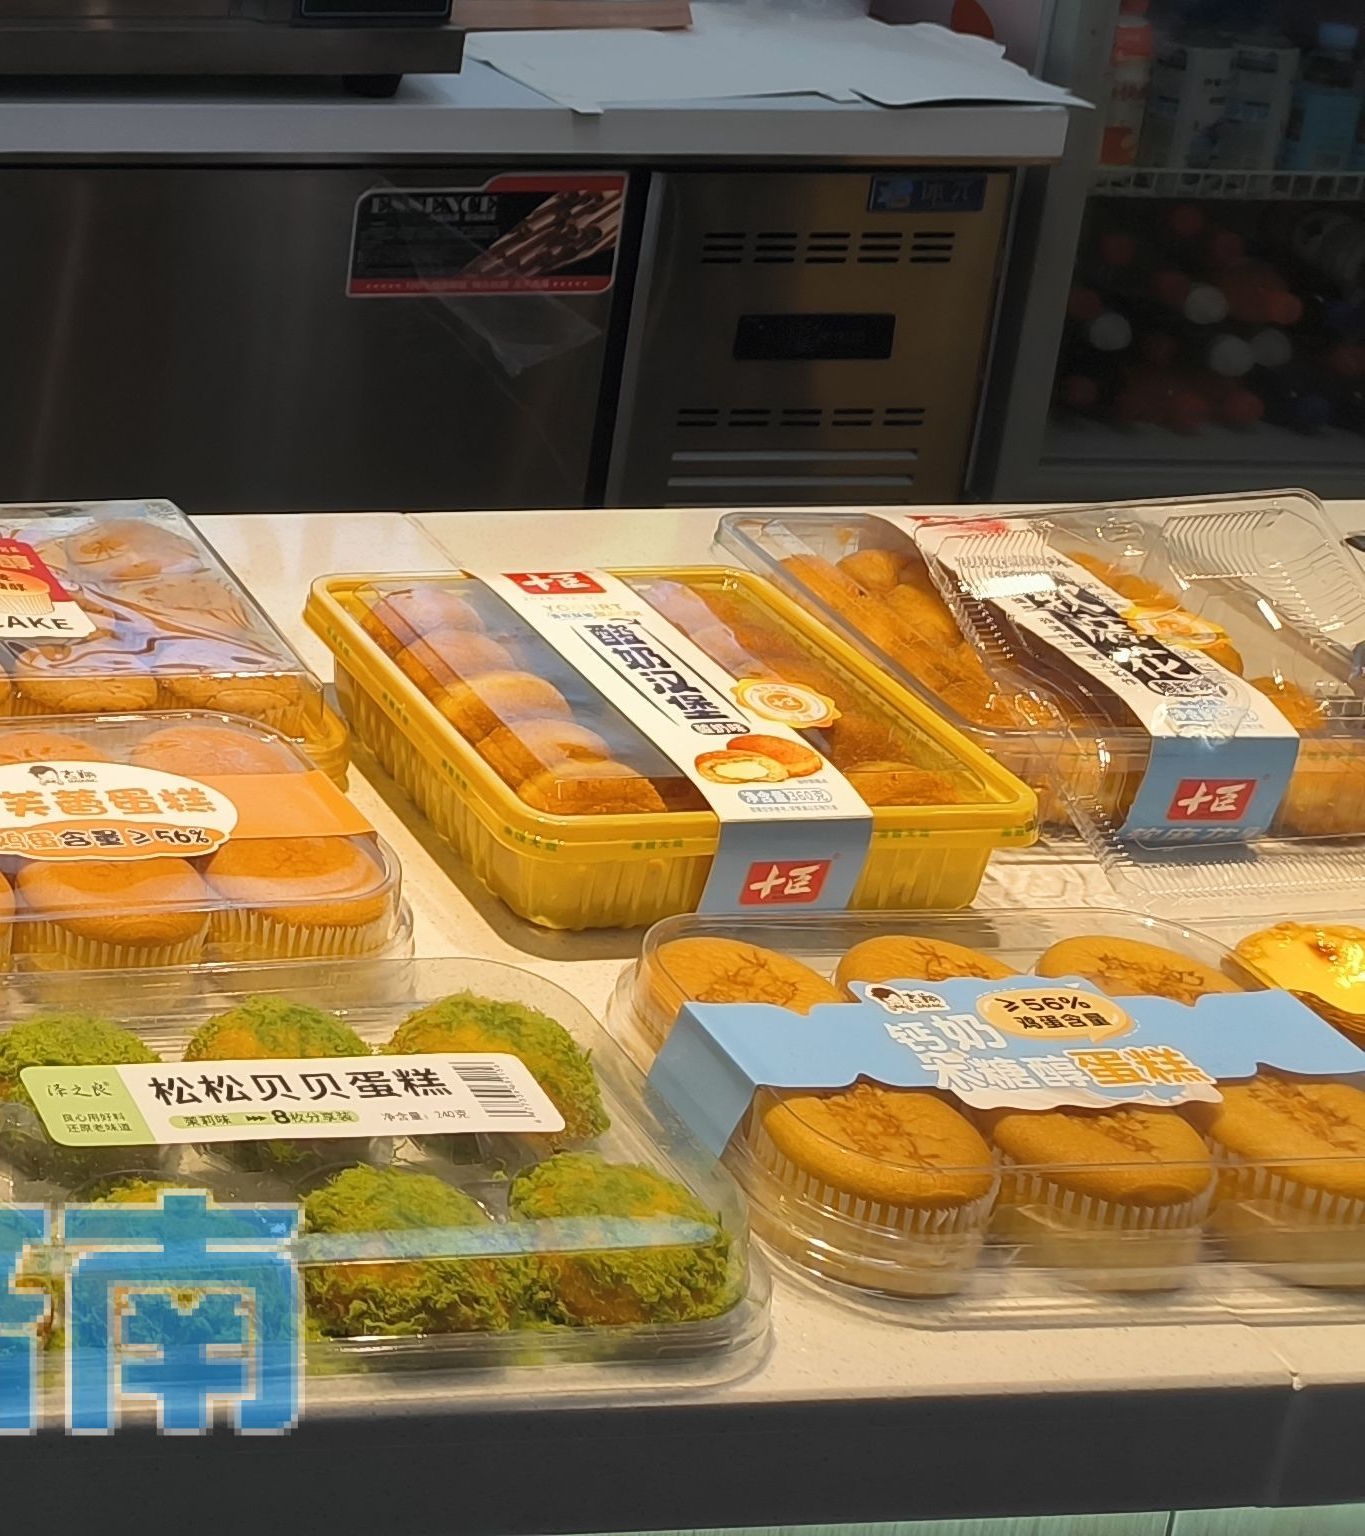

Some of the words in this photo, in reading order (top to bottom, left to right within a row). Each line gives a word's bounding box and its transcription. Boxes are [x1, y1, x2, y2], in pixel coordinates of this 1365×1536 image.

[584, 624, 729, 720] 酸奶汉堡
[884, 1014, 1008, 1053] 钙奶
[1013, 1013, 1114, 1031] 鸡蛋含量
[148, 1068, 452, 1106] 松松贝贝蛋糕
[61, 1112, 125, 1123] 良心用好料
[271, 1109, 354, 1125] 8枚分享装
